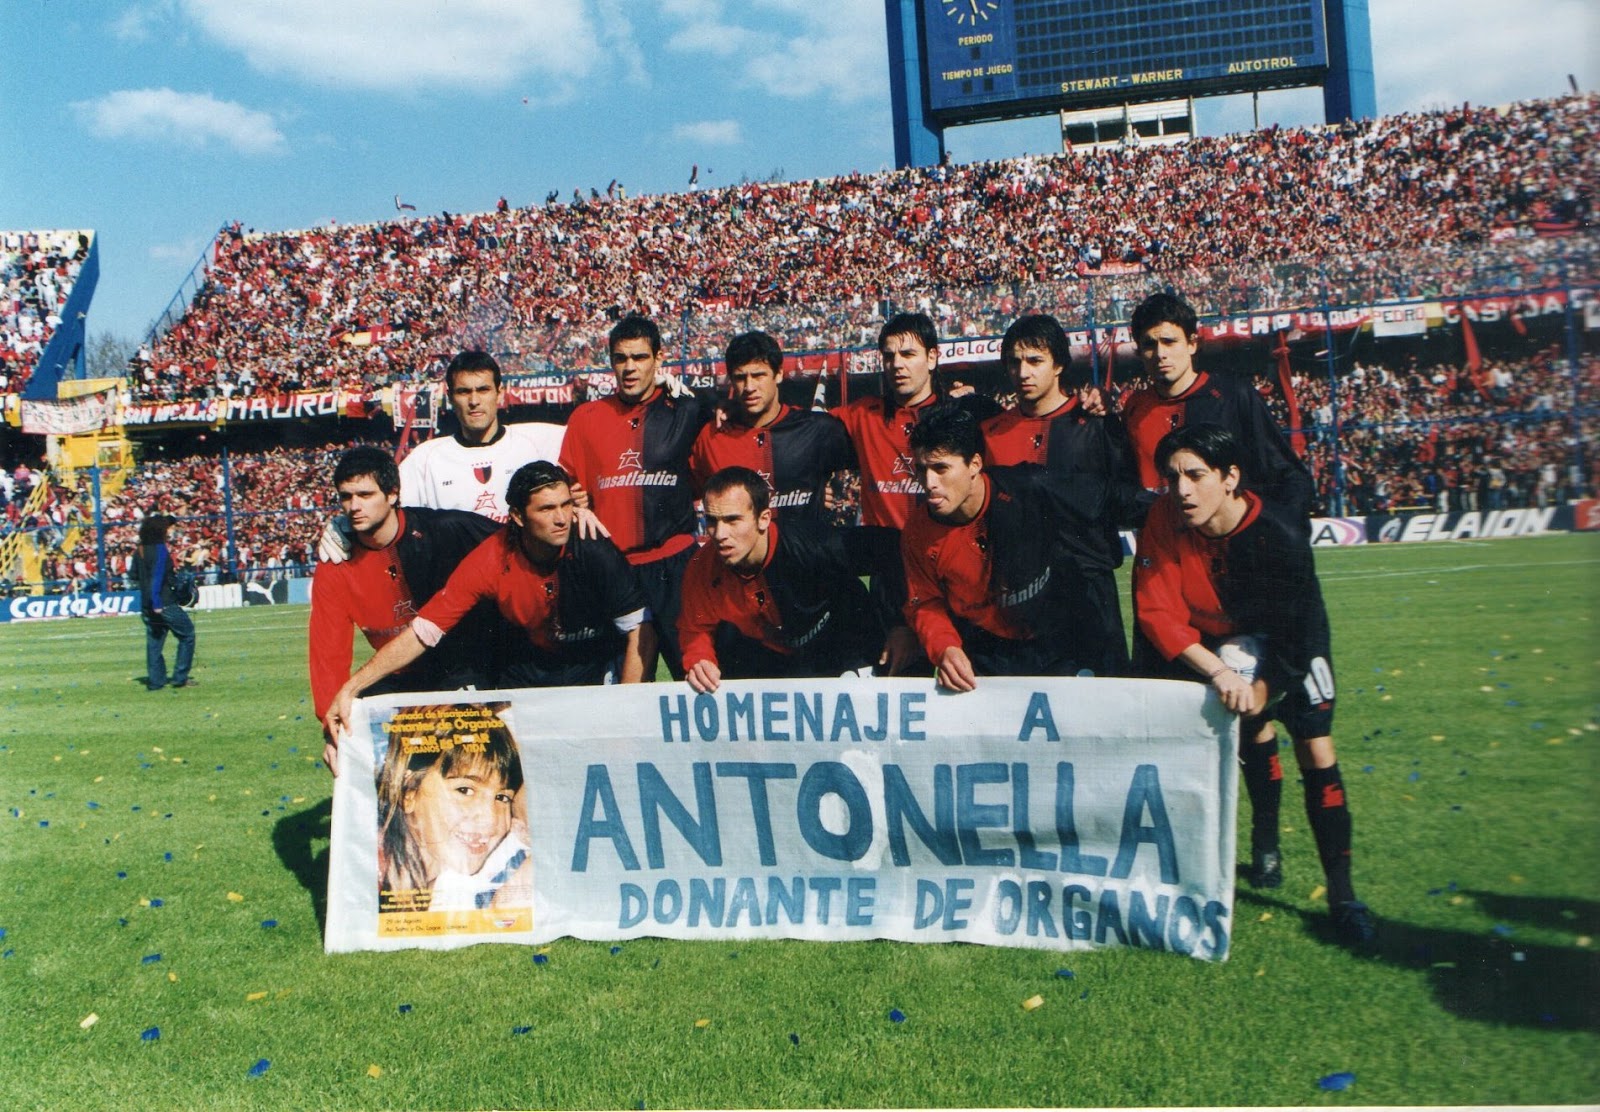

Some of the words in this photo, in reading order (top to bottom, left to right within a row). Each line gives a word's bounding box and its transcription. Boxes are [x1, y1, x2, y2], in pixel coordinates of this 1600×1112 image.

[957, 33, 993, 46] PERIODO
[941, 69, 973, 81] TIEMPO
[973, 68, 985, 78] DE
[986, 64, 1013, 76] JUEGO
[1228, 56, 1298, 74] AUTOTROL
[1061, 77, 1118, 94] STEWART
[1131, 69, 1184, 86] WARNER
[226, 391, 339, 420] MAURO
[1401, 507, 1558, 542] ELAION
[9, 593, 134, 617] CartaSur
[1303, 656, 1335, 705] 10
[382, 722, 434, 733] Donantes
[437, 720, 453, 731] de
[659, 692, 927, 742] HOMENAJE
[1018, 692, 1060, 742] A
[463, 743, 487, 753] VIDA
[571, 761, 1179, 885] ANTONELLA
[618, 877, 877, 929] DONANTE
[914, 878, 975, 931] DE
[993, 879, 1229, 962] ORGANOS
